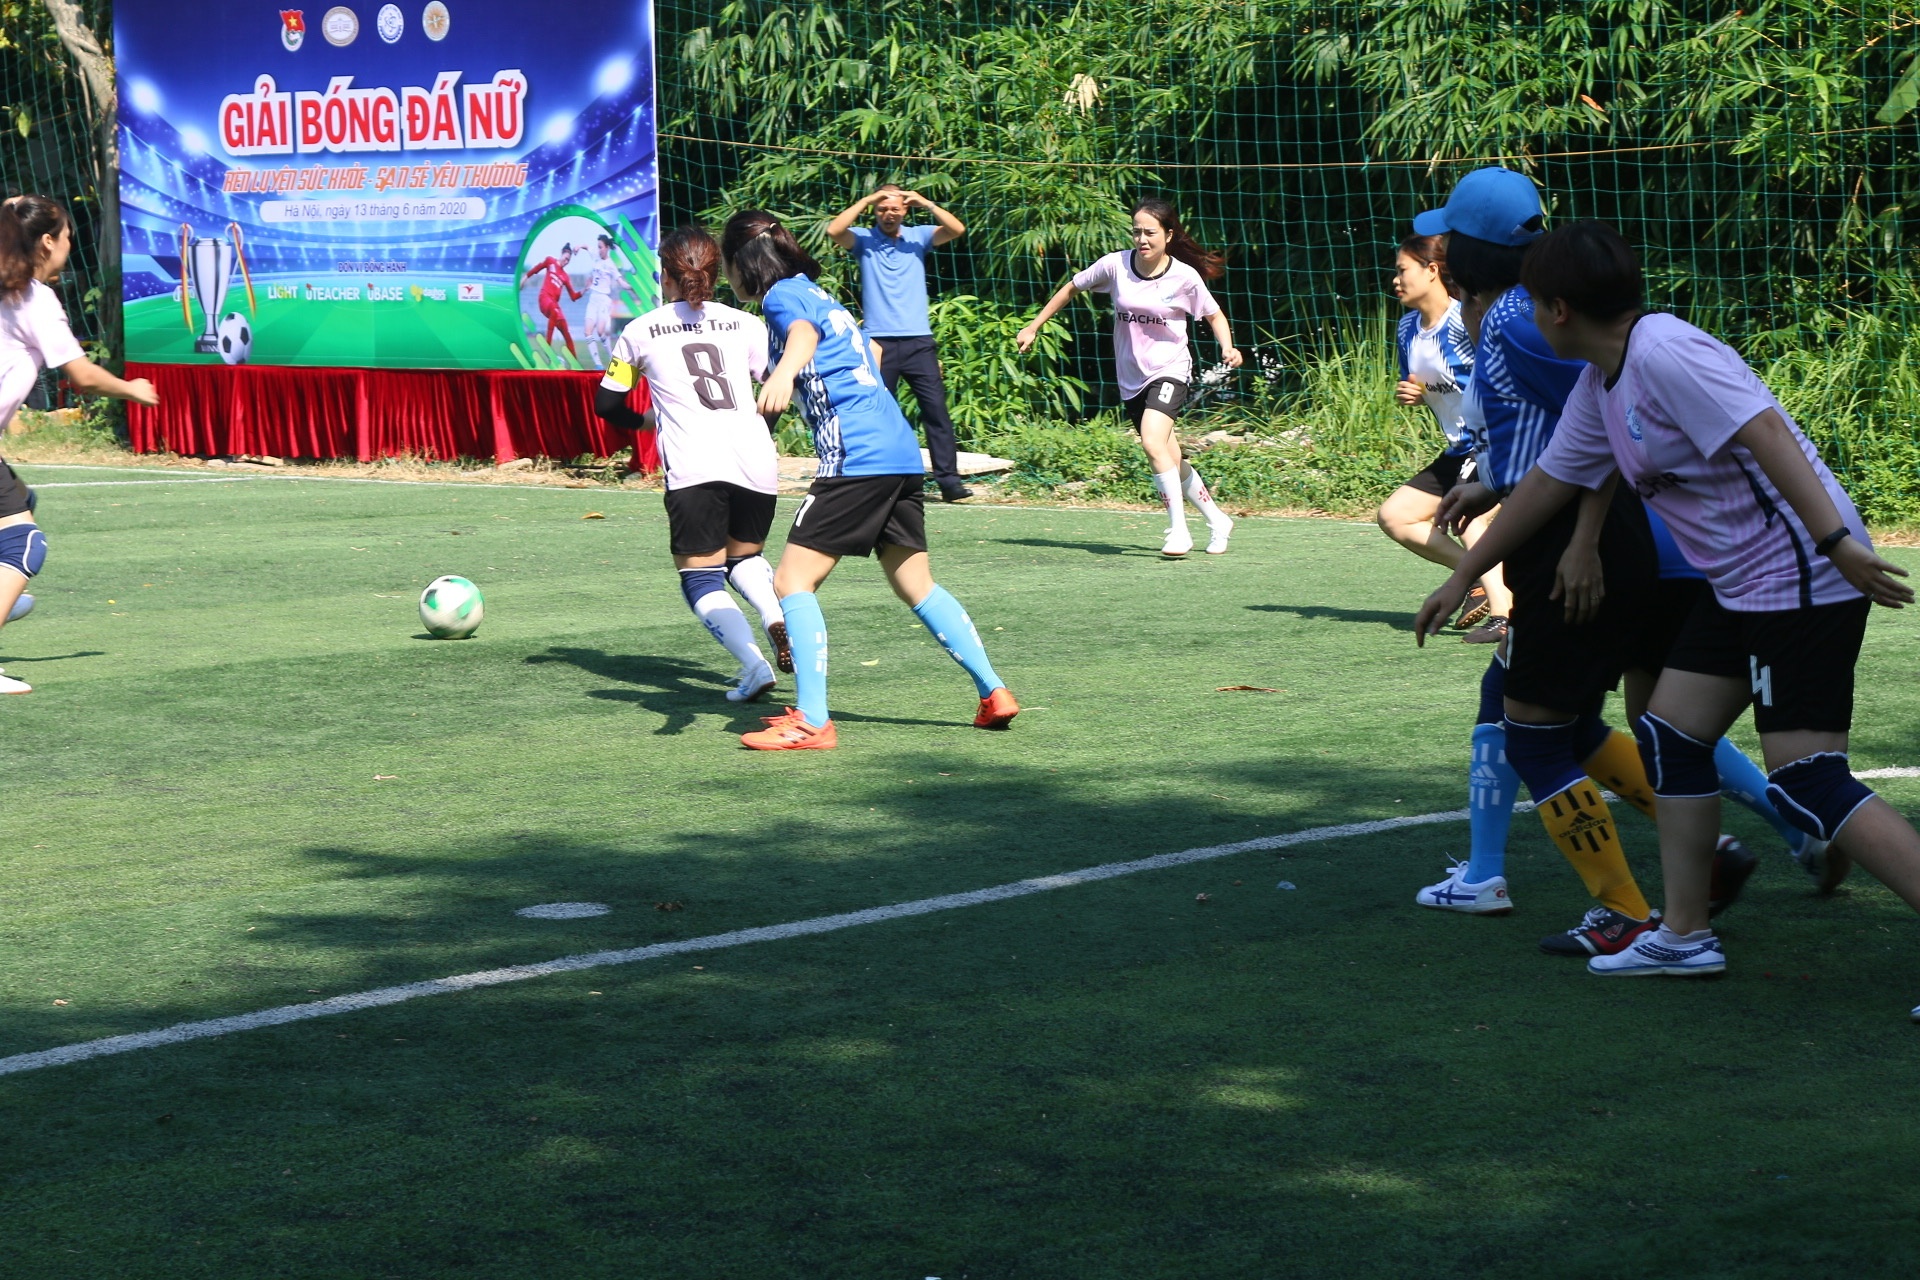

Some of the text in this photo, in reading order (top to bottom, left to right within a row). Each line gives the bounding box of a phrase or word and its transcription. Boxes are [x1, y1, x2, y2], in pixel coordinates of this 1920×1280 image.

[223, 78, 522, 148] GIẢI BÓNG ĐÁ NỮ
[297, 164, 328, 190] SỨC
[431, 162, 461, 188] YÊU
[284, 204, 299, 217] Hà
[325, 205, 350, 219] ngày
[355, 203, 367, 216] 13
[370, 203, 399, 218] tháng
[402, 203, 410, 216] 6
[412, 203, 436, 216] năm
[439, 202, 467, 215] 2020
[267, 284, 298, 299] LIGHT
[649, 318, 740, 338] Huong Tran
[680, 342, 737, 410] 8
[1157, 381, 1175, 405] 9
[1749, 654, 1773, 706] 4
[1558, 818, 1608, 838] adidas
